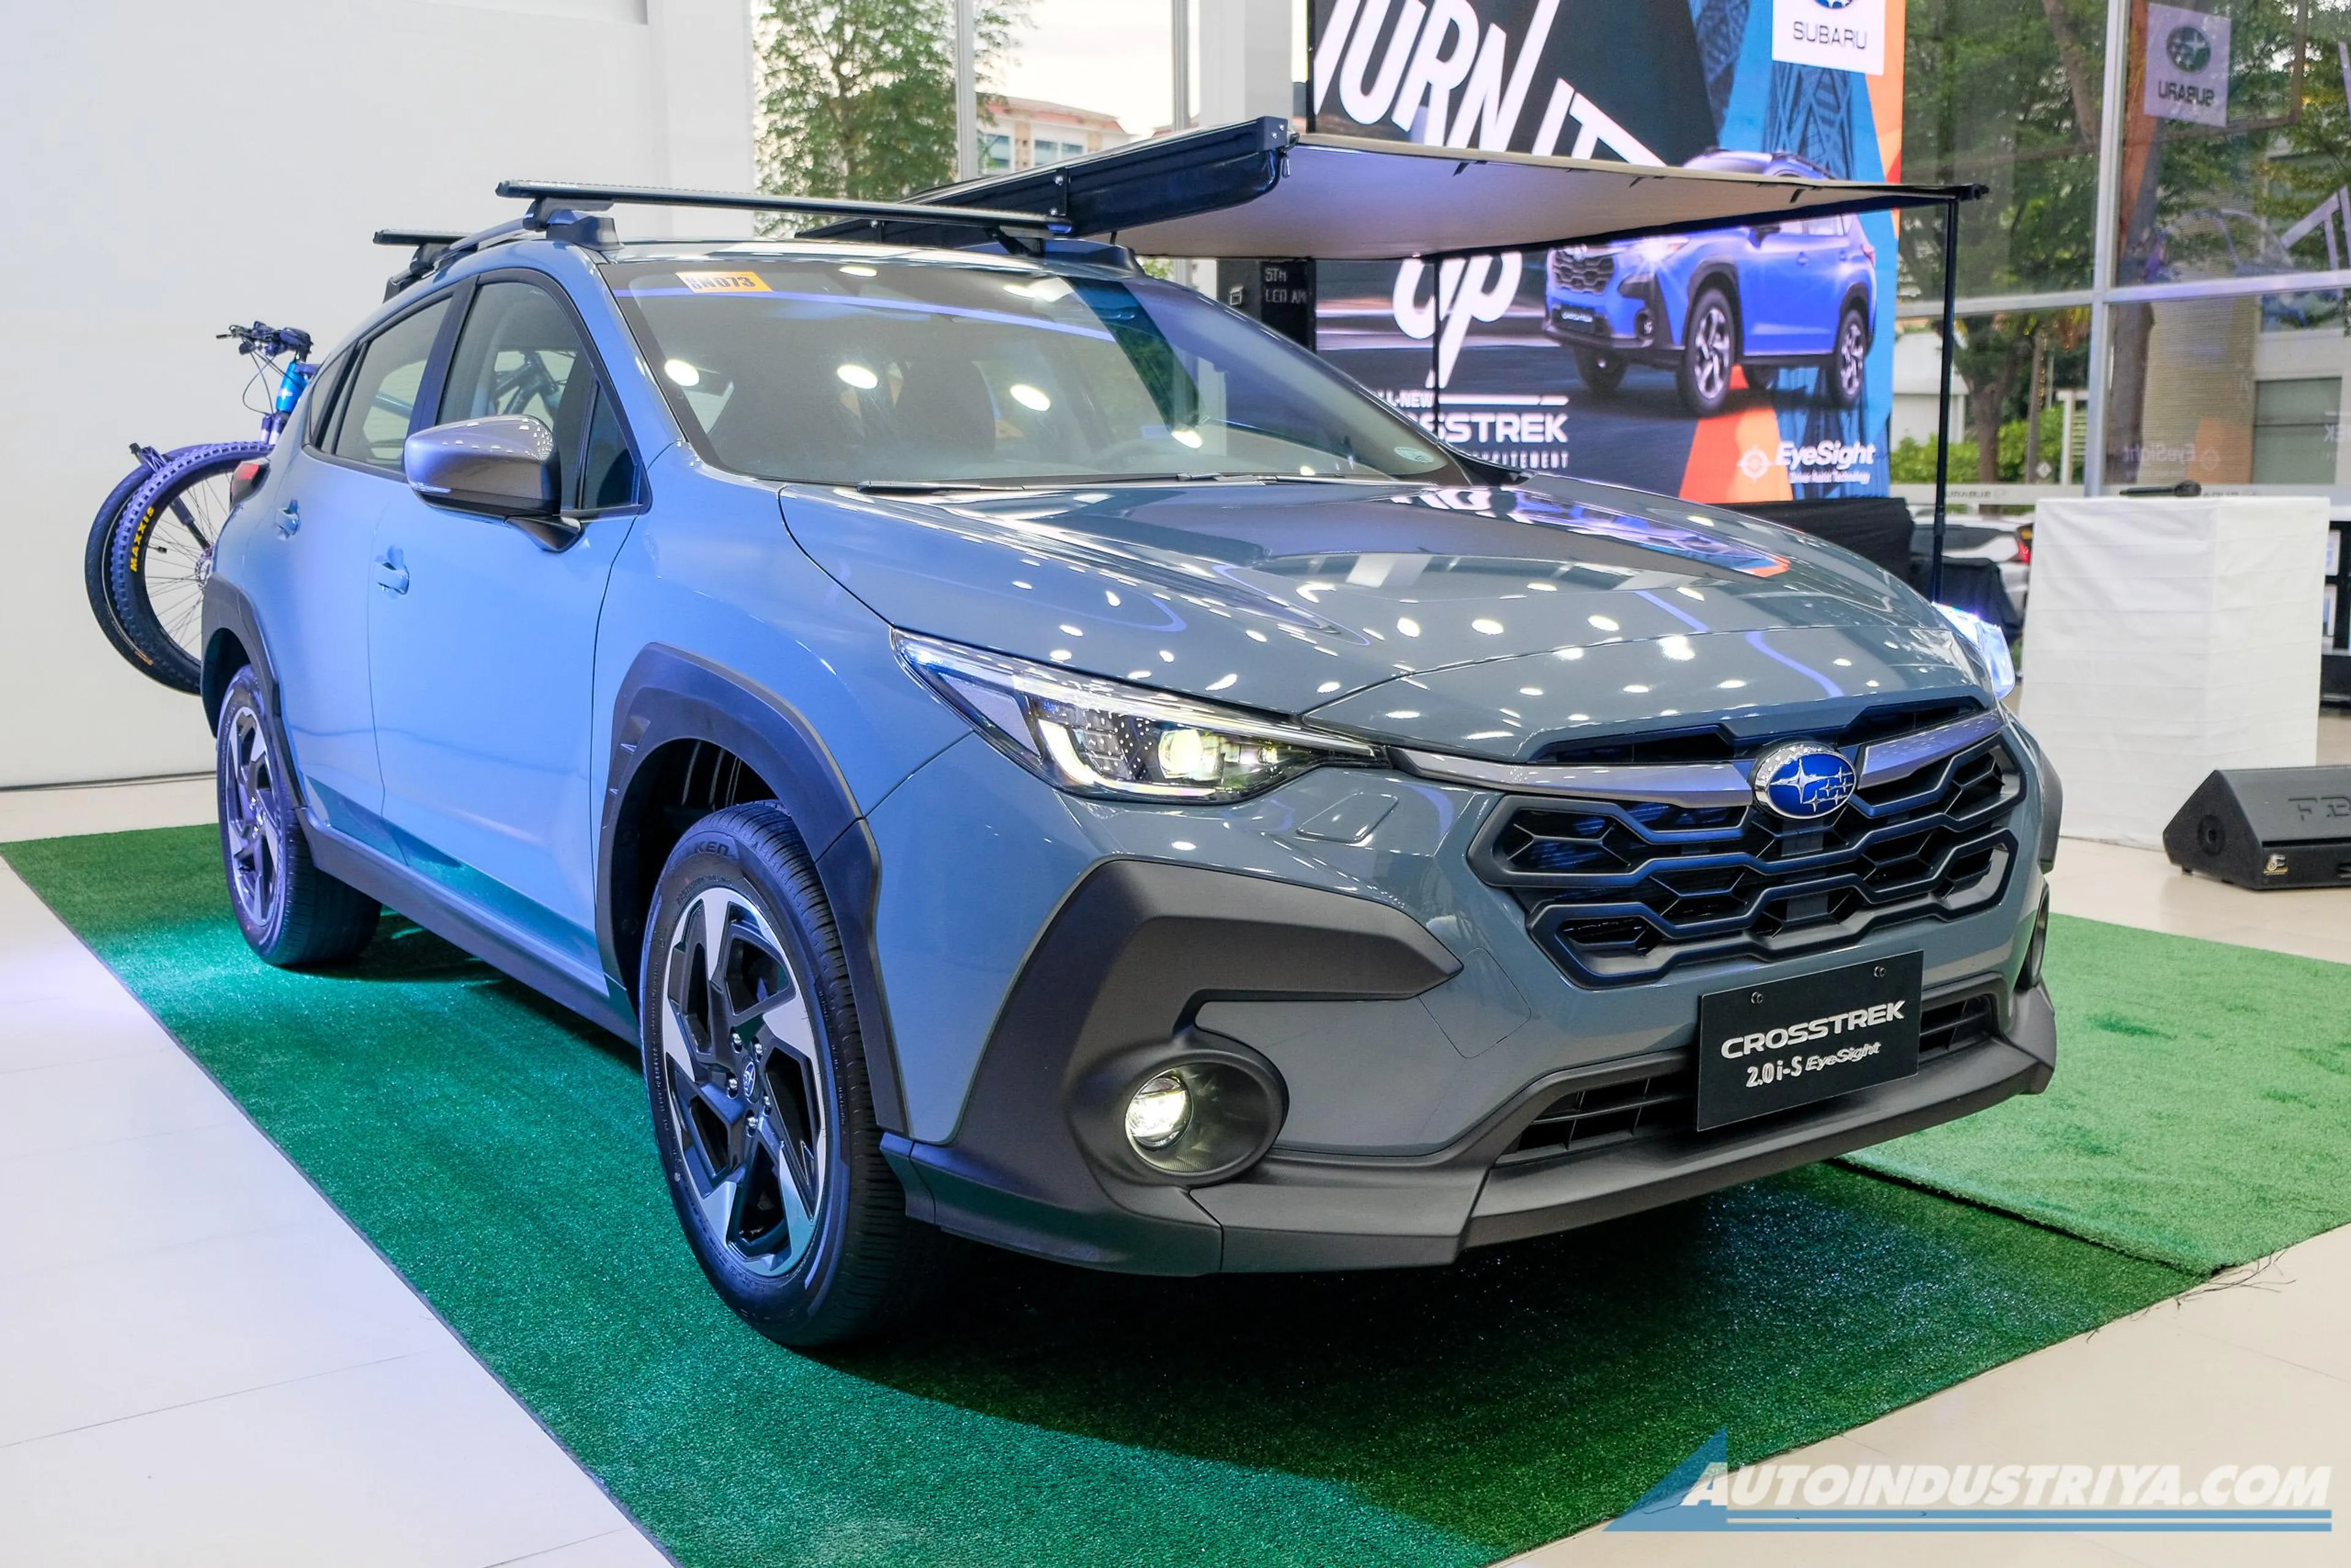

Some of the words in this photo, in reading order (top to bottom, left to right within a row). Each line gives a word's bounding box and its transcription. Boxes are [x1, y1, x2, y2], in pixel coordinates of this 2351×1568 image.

[1793, 21, 1867, 49] SUBARU
[1775, 440, 1876, 470] EyeSight
[130, 506, 155, 572] MAXXIS
[1720, 1000, 1906, 1059] CROSSTREK
[1805, 1041, 1882, 1071] EyeSight
